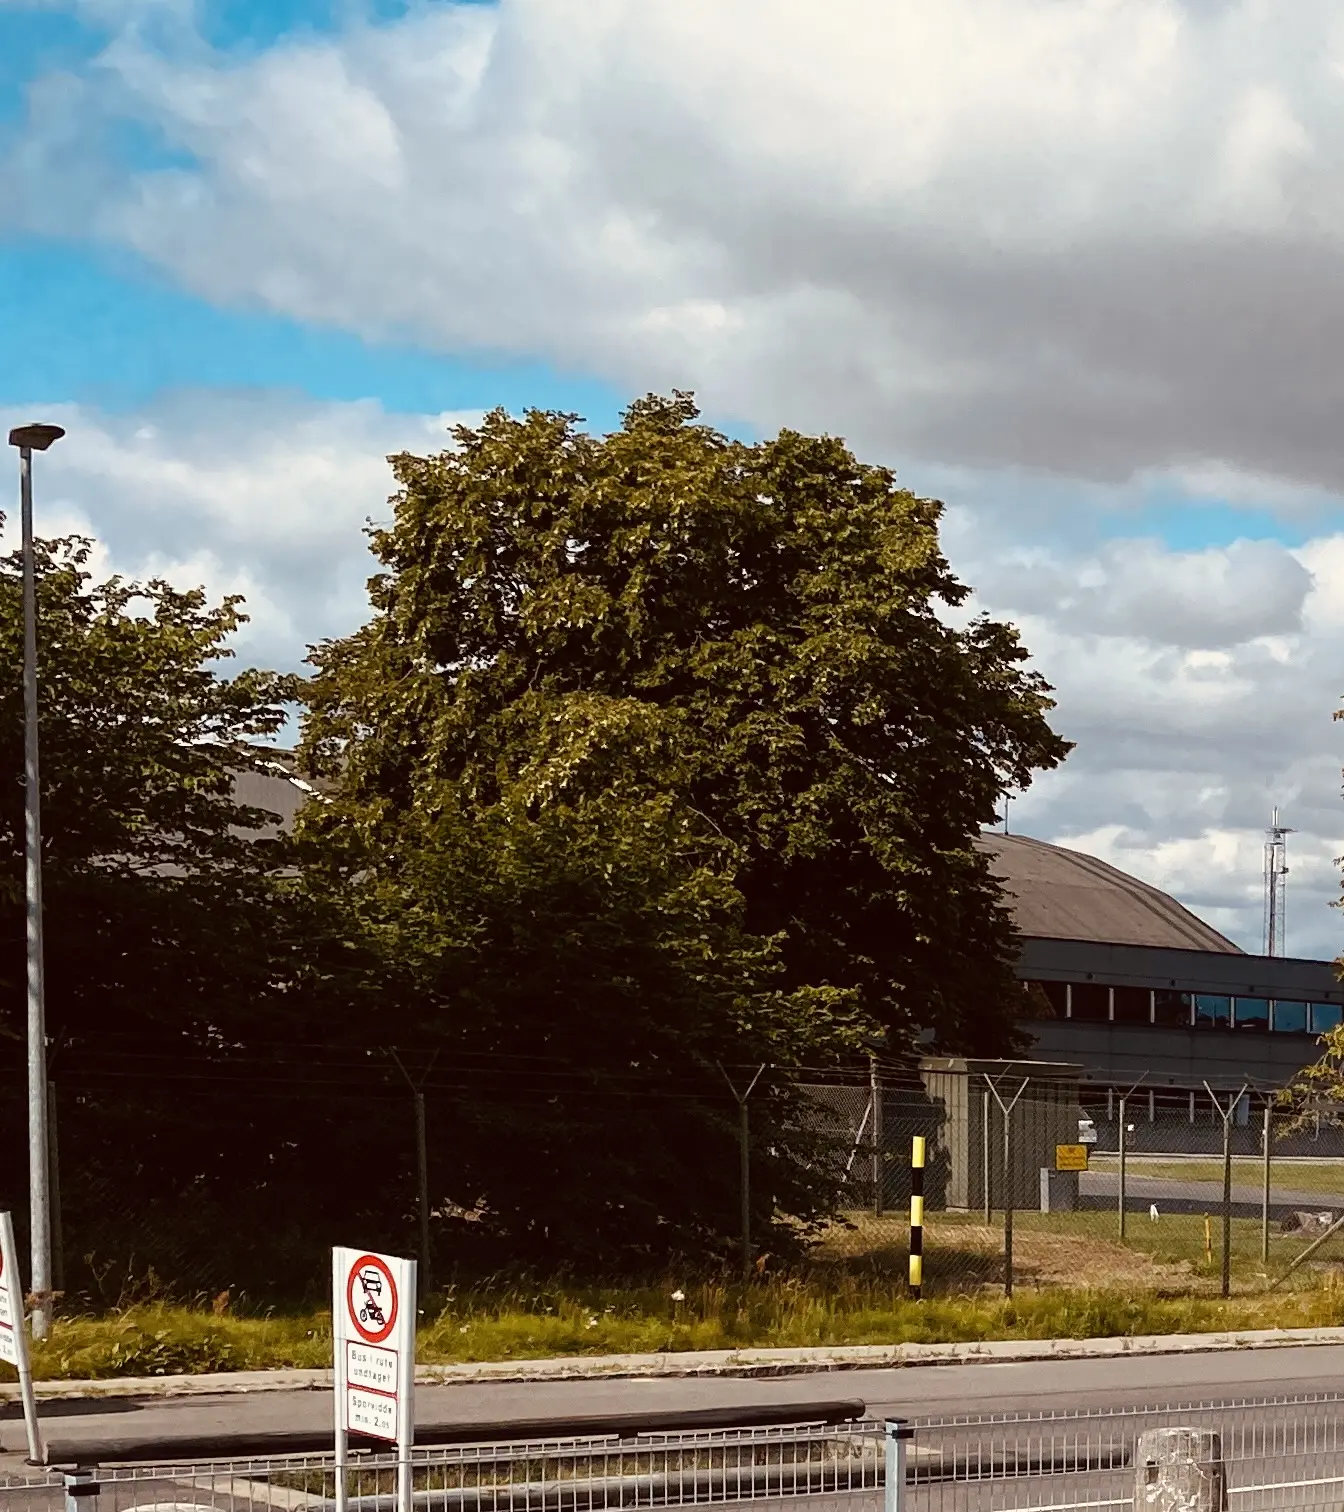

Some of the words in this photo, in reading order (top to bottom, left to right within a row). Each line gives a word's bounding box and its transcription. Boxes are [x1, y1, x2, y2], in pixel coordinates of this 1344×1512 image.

[352, 1349, 367, 1362] Bus
[376, 1357, 393, 1368] rute
[354, 1368, 391, 1383] undtaget
[352, 1396, 392, 1414] Sporvidde
